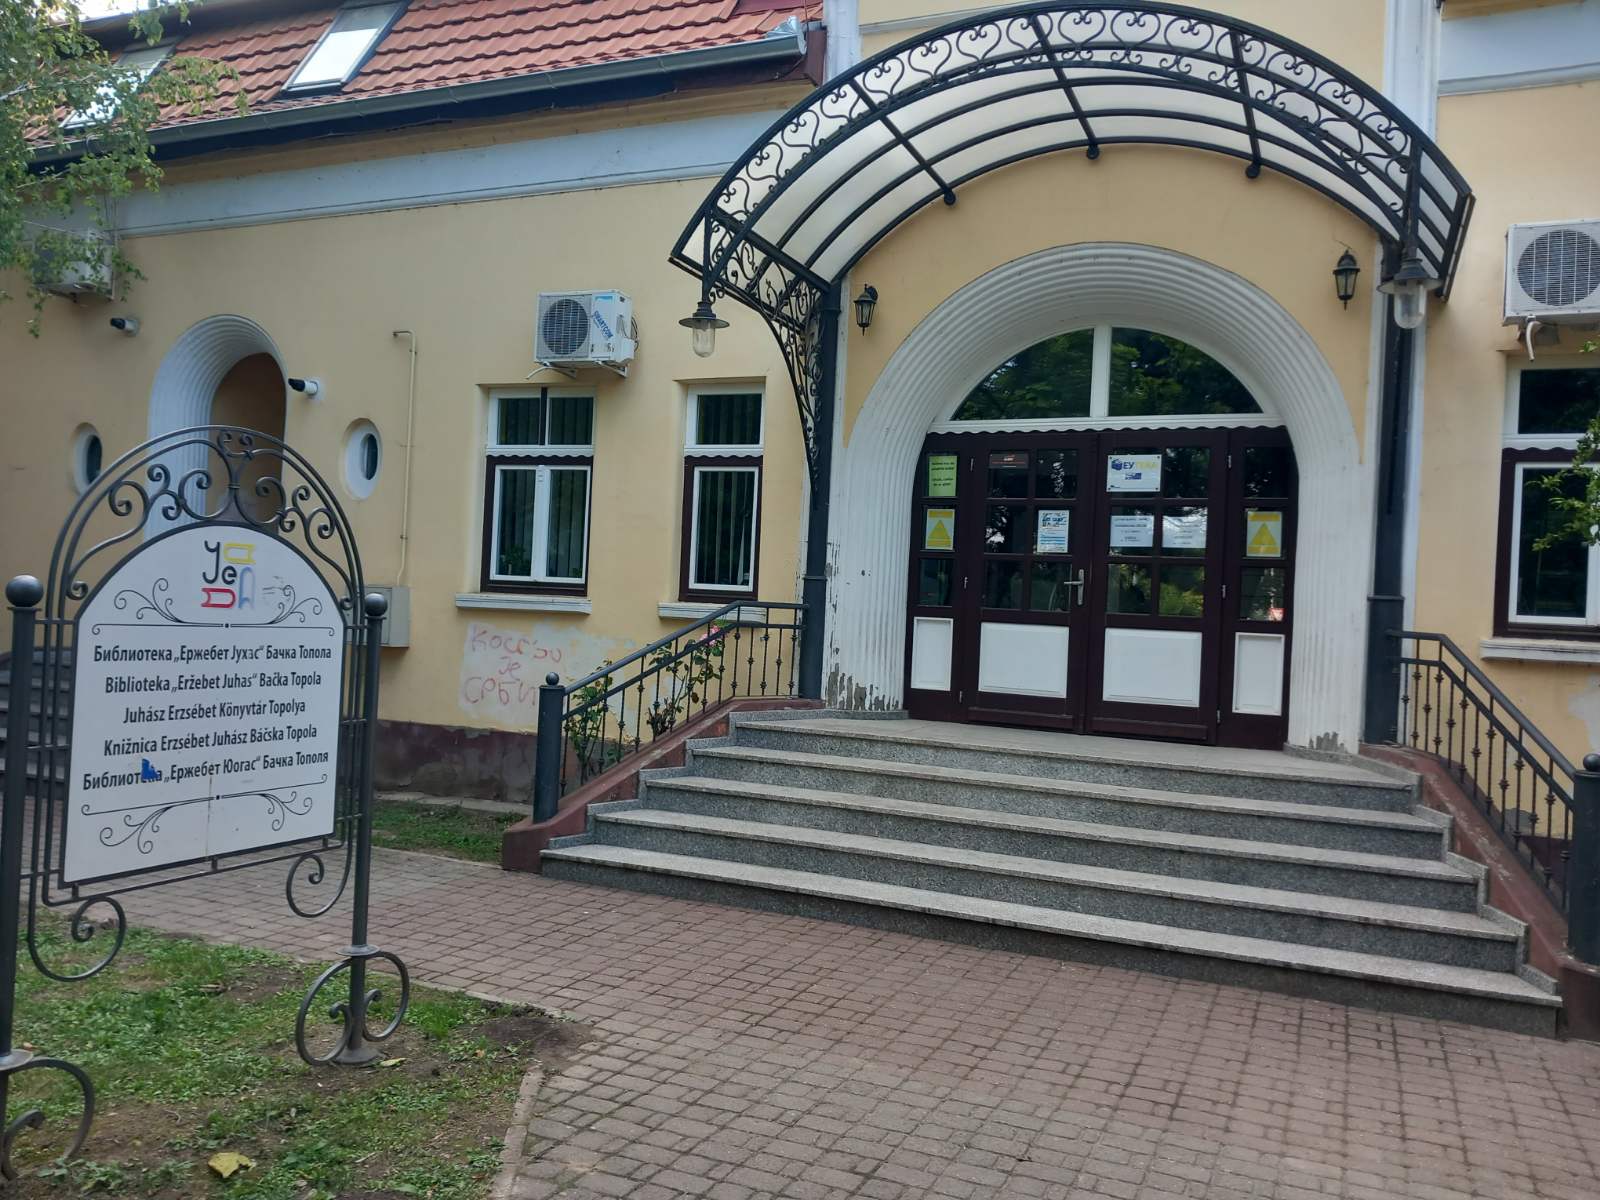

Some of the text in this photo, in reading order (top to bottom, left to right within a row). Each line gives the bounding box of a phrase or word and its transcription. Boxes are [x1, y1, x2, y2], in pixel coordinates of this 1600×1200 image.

[94, 645, 172, 662] Библиотека
[266, 645, 297, 660] Бачка
[299, 645, 332, 659] Топола
[105, 675, 170, 693] Biblioteka
[259, 672, 289, 687] Bačka
[291, 671, 322, 689] Topola
[123, 698, 306, 724] Juhász Erzsébet Könyvtár Topolya
[104, 723, 317, 756] Knižnica Erzsébet Juhász Báčska Topola
[263, 754, 294, 769] Бачка
[296, 751, 329, 766] Тополя
